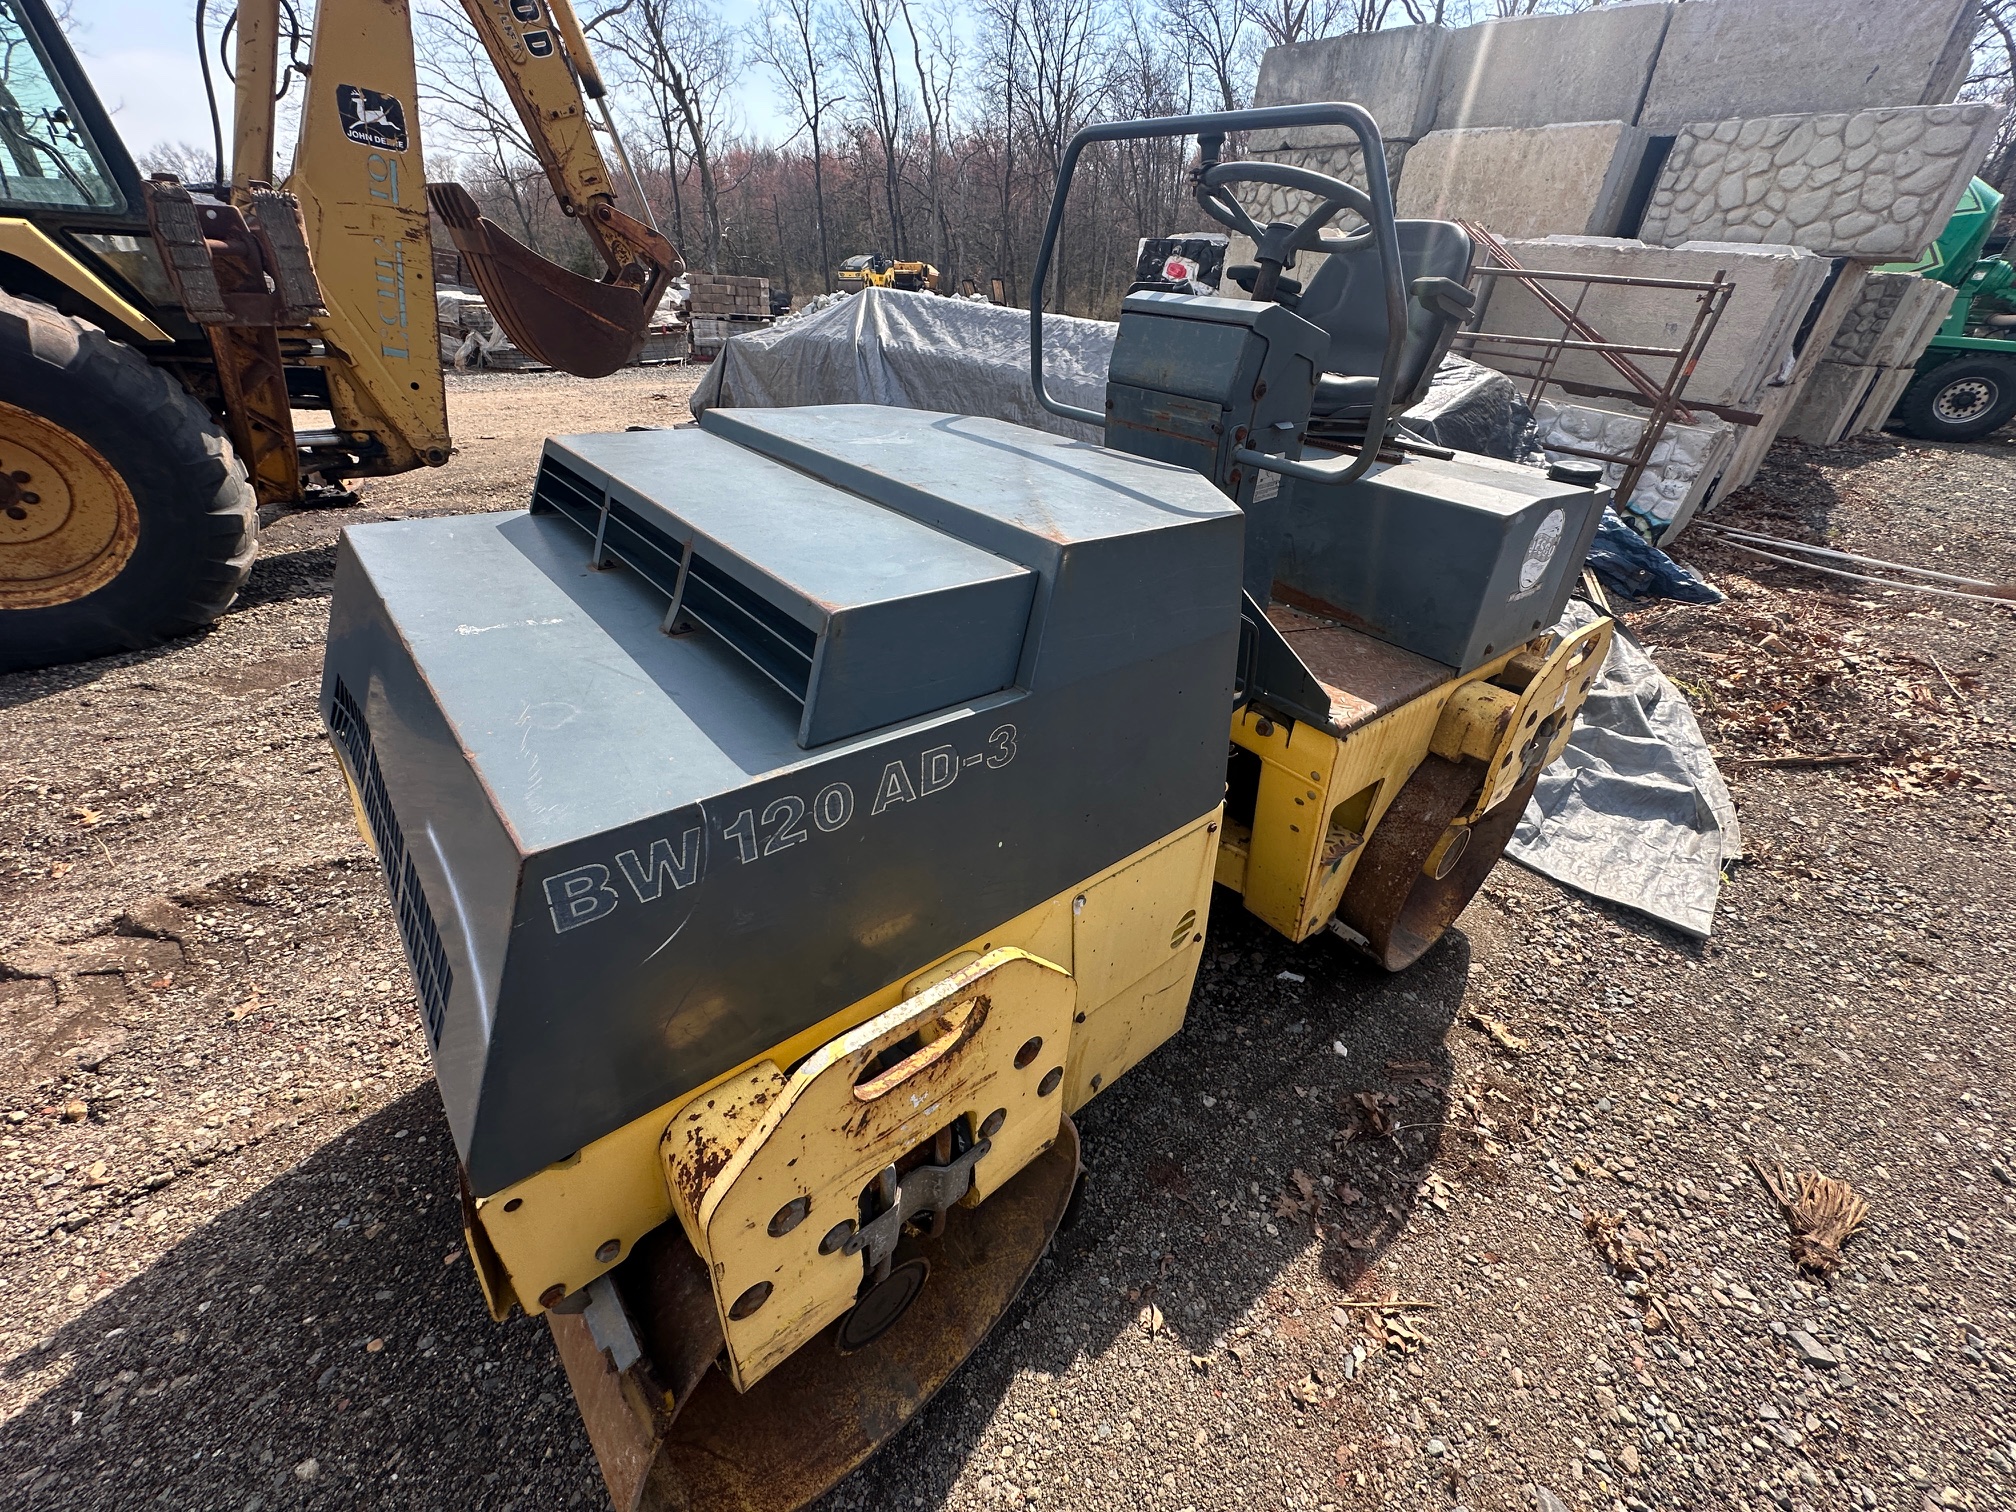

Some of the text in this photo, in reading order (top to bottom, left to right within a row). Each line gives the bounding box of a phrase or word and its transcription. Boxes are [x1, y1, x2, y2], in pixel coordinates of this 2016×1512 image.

[347, 129, 373, 143] JOHN
[542, 723, 1018, 934] BW 120 AD-3
